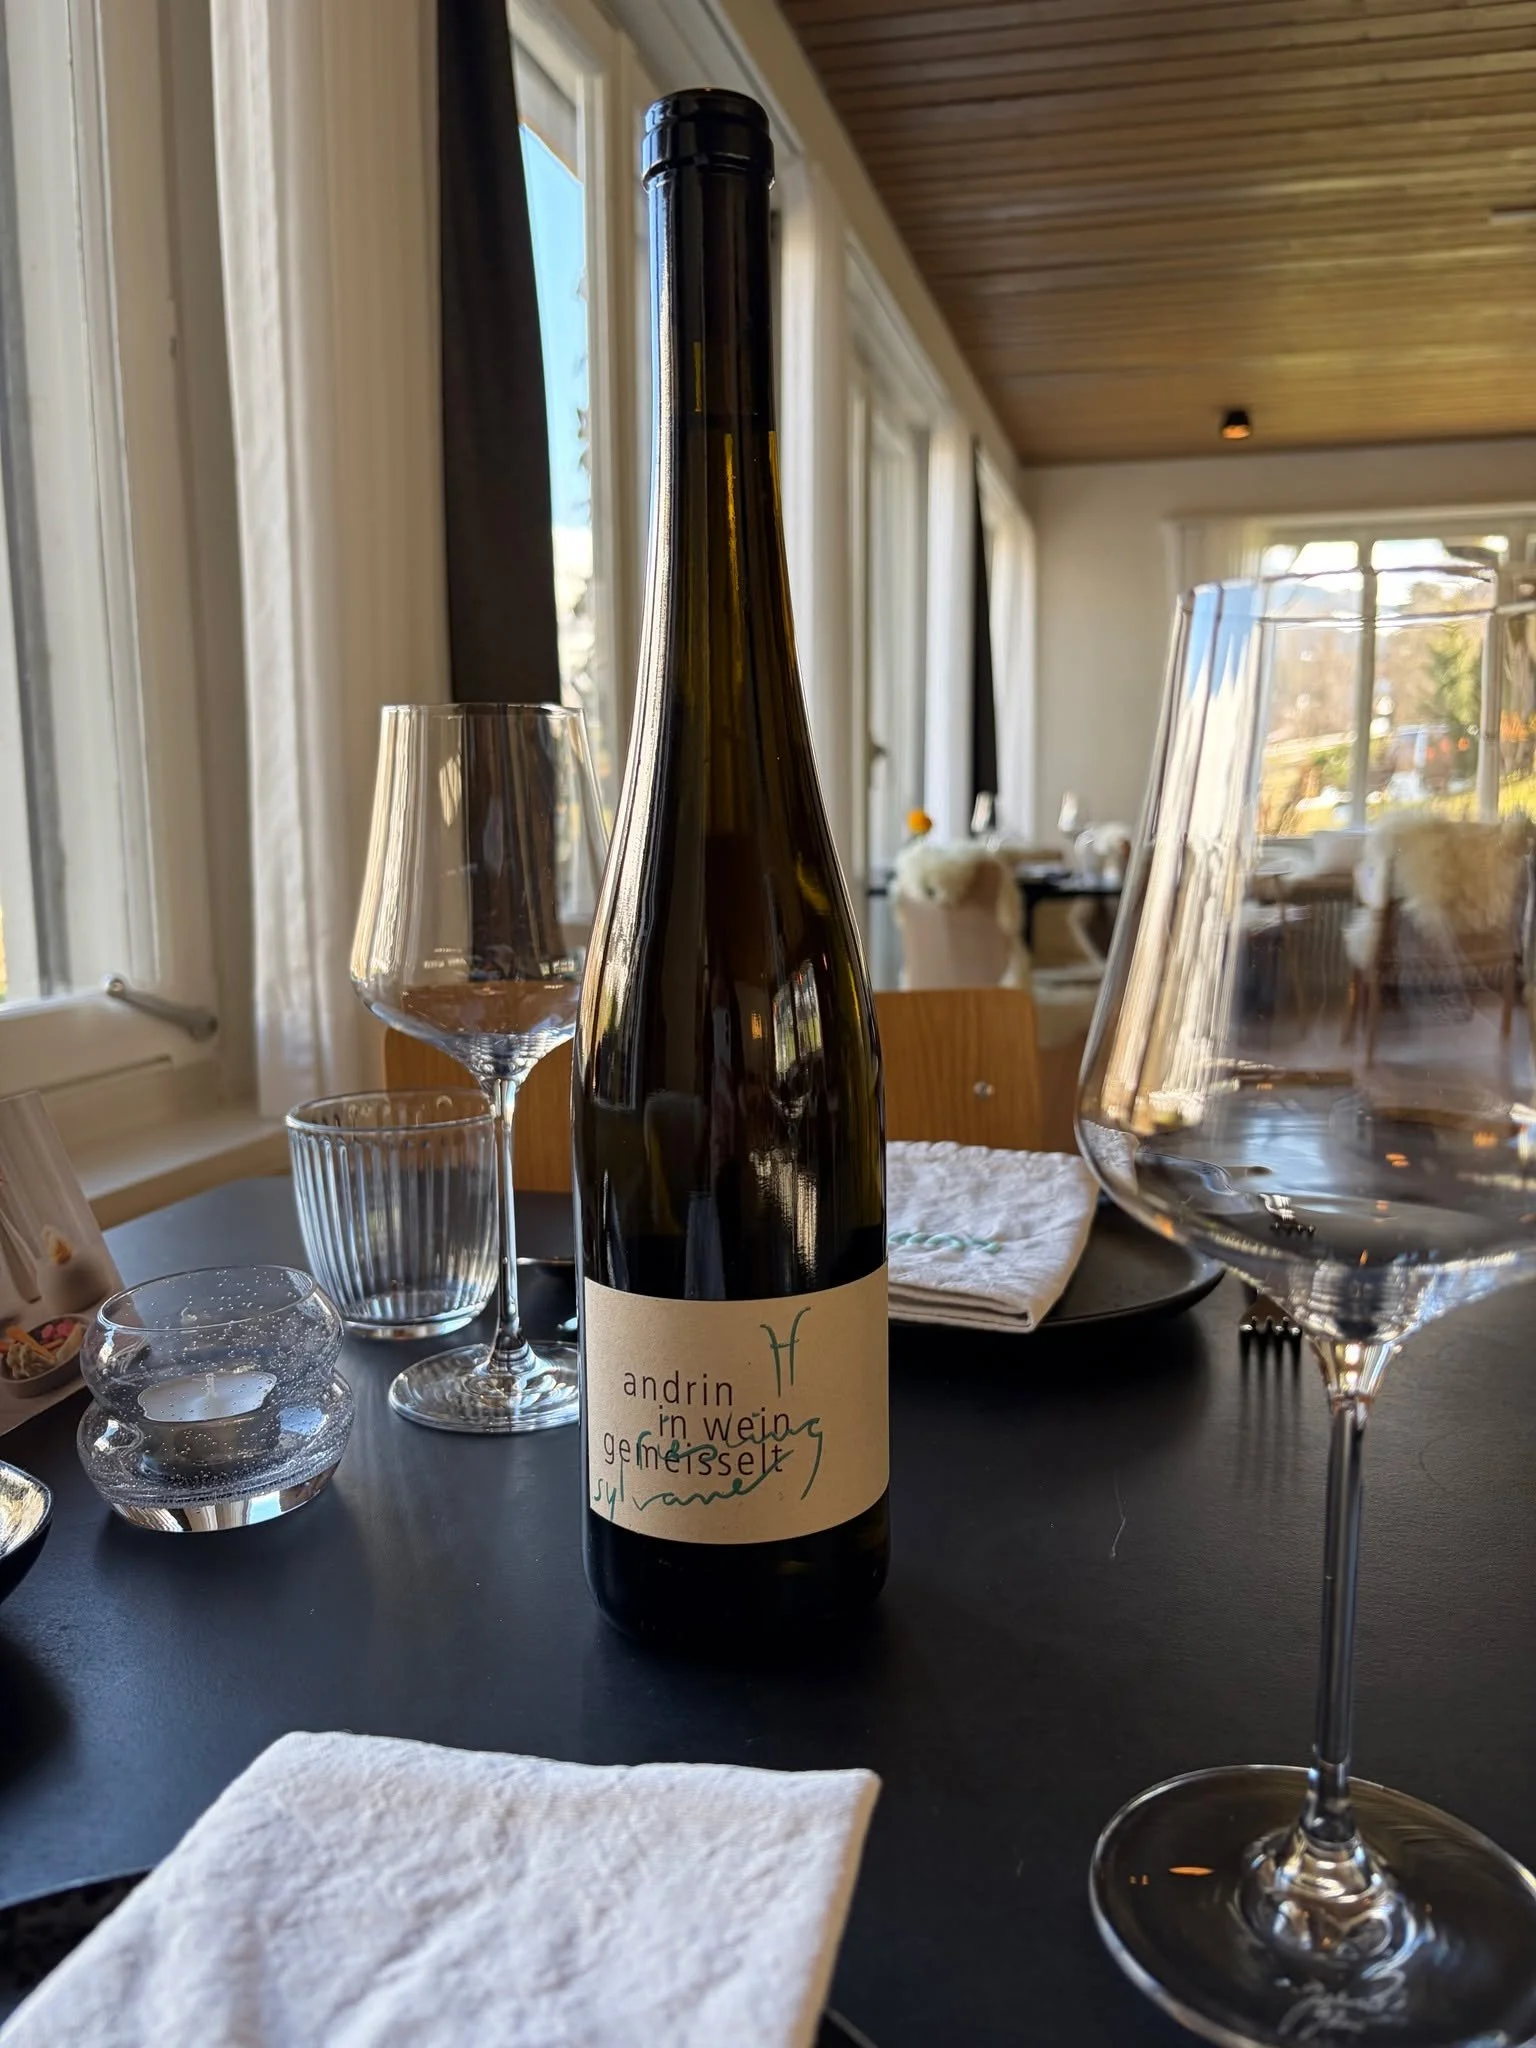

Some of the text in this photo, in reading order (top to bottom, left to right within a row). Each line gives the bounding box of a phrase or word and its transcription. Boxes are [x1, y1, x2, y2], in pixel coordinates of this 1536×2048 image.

[623, 1370, 732, 1405] andrin
[658, 1405, 790, 1441] in wein
[604, 1432, 783, 1475] gemeisselt
